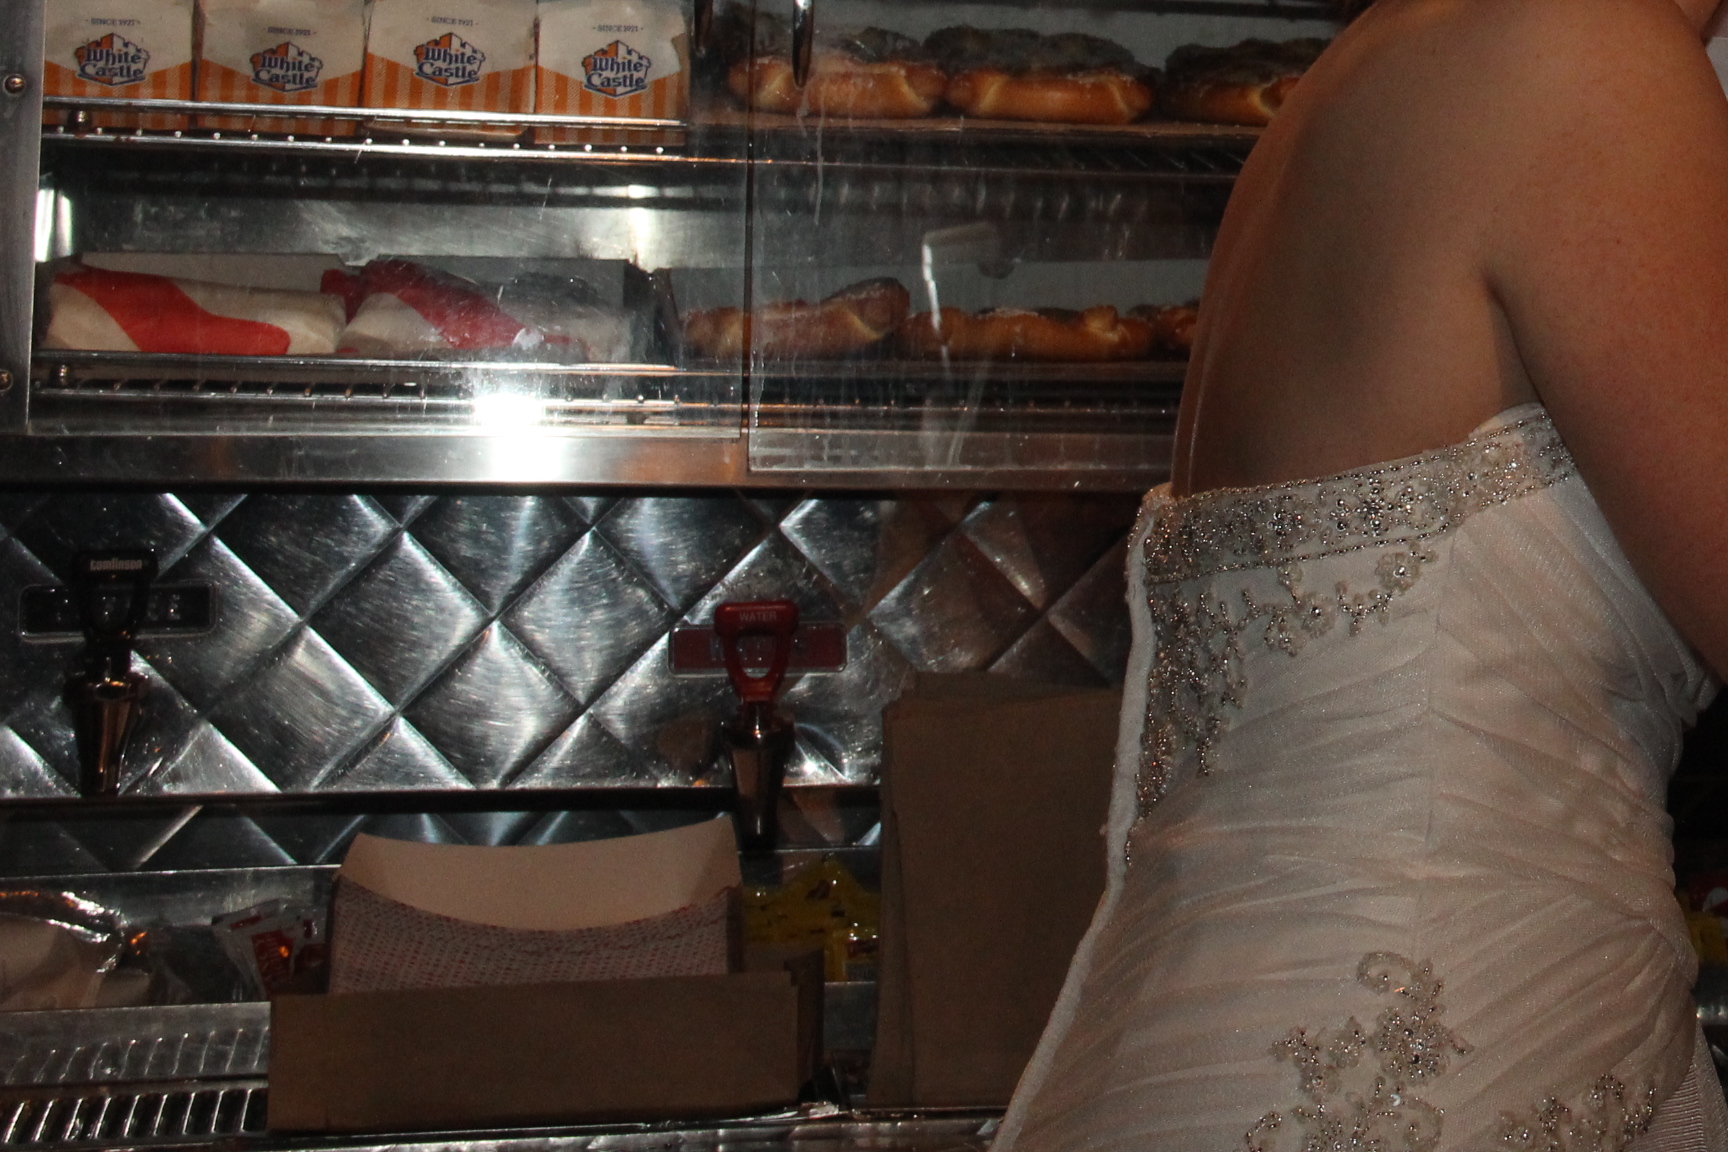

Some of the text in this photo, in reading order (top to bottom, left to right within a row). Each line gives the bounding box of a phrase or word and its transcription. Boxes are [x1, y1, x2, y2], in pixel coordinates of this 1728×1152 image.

[86, 49, 141, 65] White
[262, 56, 314, 72] White
[425, 48, 477, 65] White
[80, 63, 143, 78] Castle
[419, 62, 479, 79] Castle
[592, 57, 642, 74] White
[255, 69, 316, 85] Castle
[587, 74, 645, 88] Castle
[90, 558, 143, 571] tomlinson
[740, 611, 777, 621] WATER
